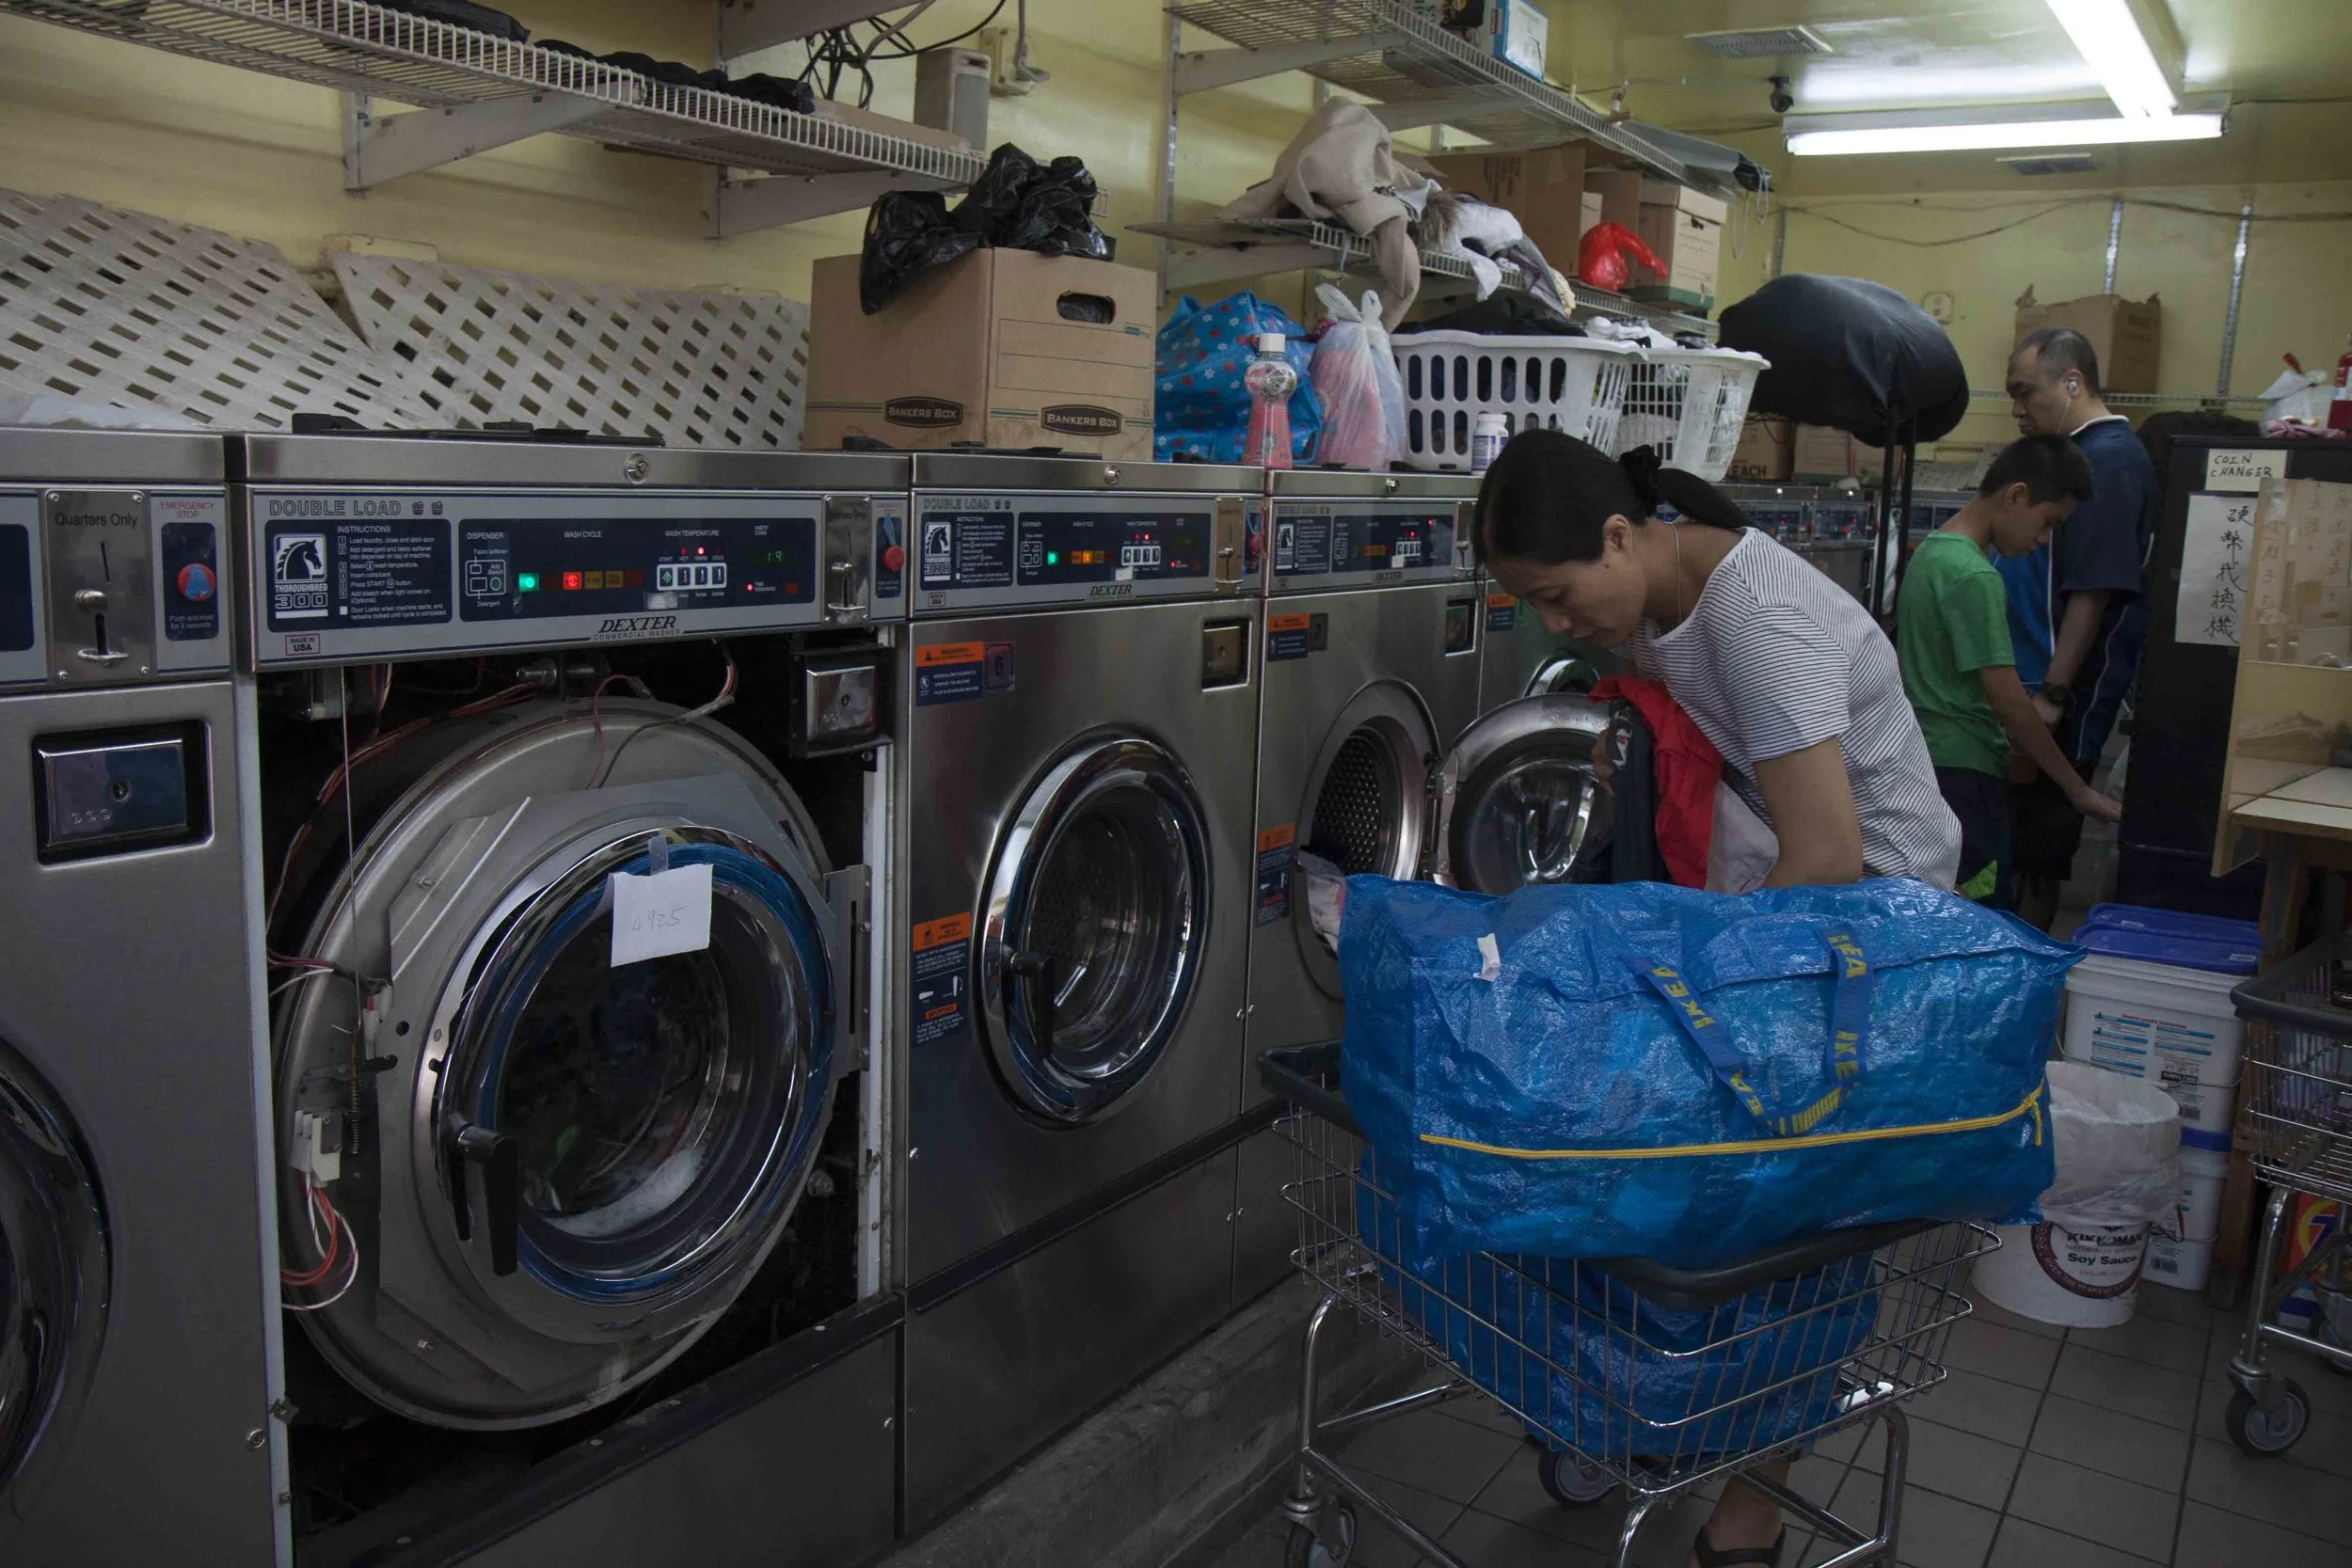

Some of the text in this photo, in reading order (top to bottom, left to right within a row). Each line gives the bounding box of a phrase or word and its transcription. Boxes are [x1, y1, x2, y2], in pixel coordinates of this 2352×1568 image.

[888, 406, 958, 419] BANKERS BOX
[1046, 413, 1118, 428] BANKERS BOX
[2214, 453, 2252, 465] COIN
[2210, 467, 2272, 478] CHANGER
[160, 500, 214, 509] EMERGENCY
[269, 500, 401, 516] DOUBLE LOAD
[965, 499, 990, 509] LOAD
[176, 510, 199, 518] STOP
[55, 513, 137, 529] Quarters Only
[338, 525, 391, 533] INSTRUCTIONS
[924, 563, 951, 575] 300
[275, 583, 328, 594] THOROUGHBRED
[1089, 584, 1133, 596] DEXTER
[275, 593, 328, 610] 300
[598, 616, 676, 633] DEXTER
[594, 632, 645, 641] COMMERCIAL
[293, 643, 312, 652] USA
[1651, 966, 1716, 1029] IKEA
[2068, 1253, 2137, 1266] Soy Sauce
